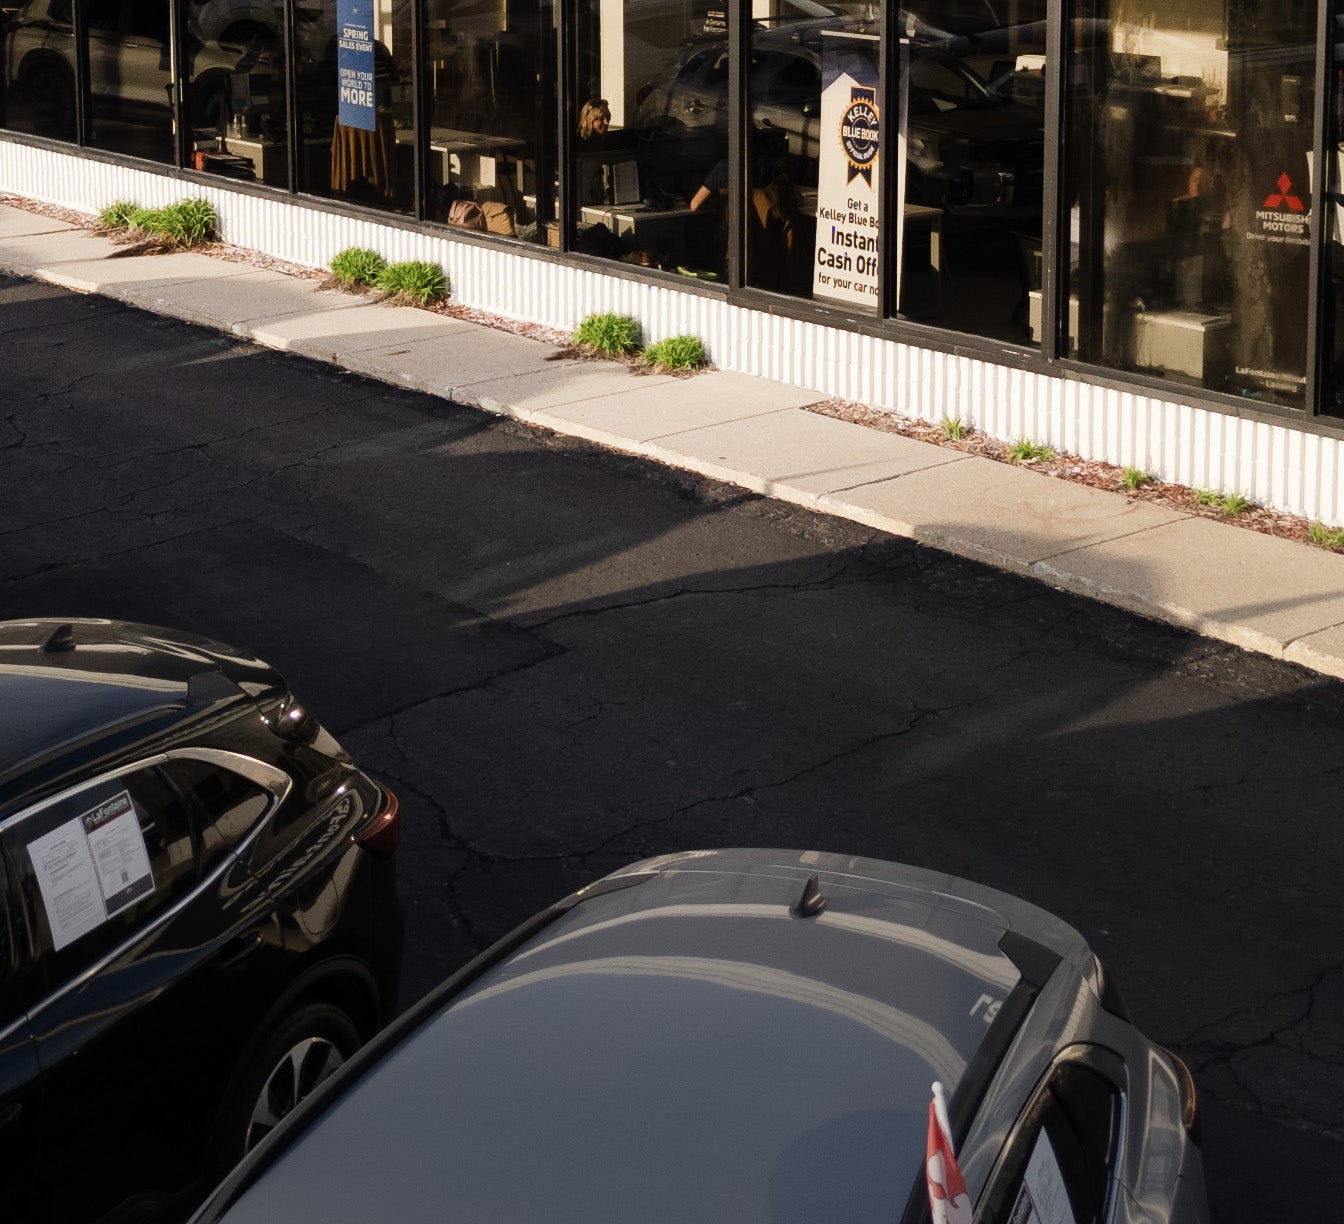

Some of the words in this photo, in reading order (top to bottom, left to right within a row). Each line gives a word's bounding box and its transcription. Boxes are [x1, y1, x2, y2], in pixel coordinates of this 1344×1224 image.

[342, 27, 369, 41] SPRING
[340, 86, 374, 108] MORE
[847, 105, 877, 126] KELLEY
[842, 125, 861, 139] BLUE
[861, 128, 879, 143] BOOK
[847, 197, 861, 211] Get
[863, 203, 869, 212] a
[819, 207, 846, 224] Kelley
[848, 212, 867, 226] Blue
[869, 217, 879, 229] Bo
[1262, 221, 1304, 234] MOTORS
[817, 247, 852, 271] Cash
[856, 255, 879, 277] Off
[818, 271, 831, 284] for
[832, 278, 852, 290] your
[853, 282, 867, 293] car
[869, 285, 879, 296] no
[92, 796, 129, 823] LaFontaine
